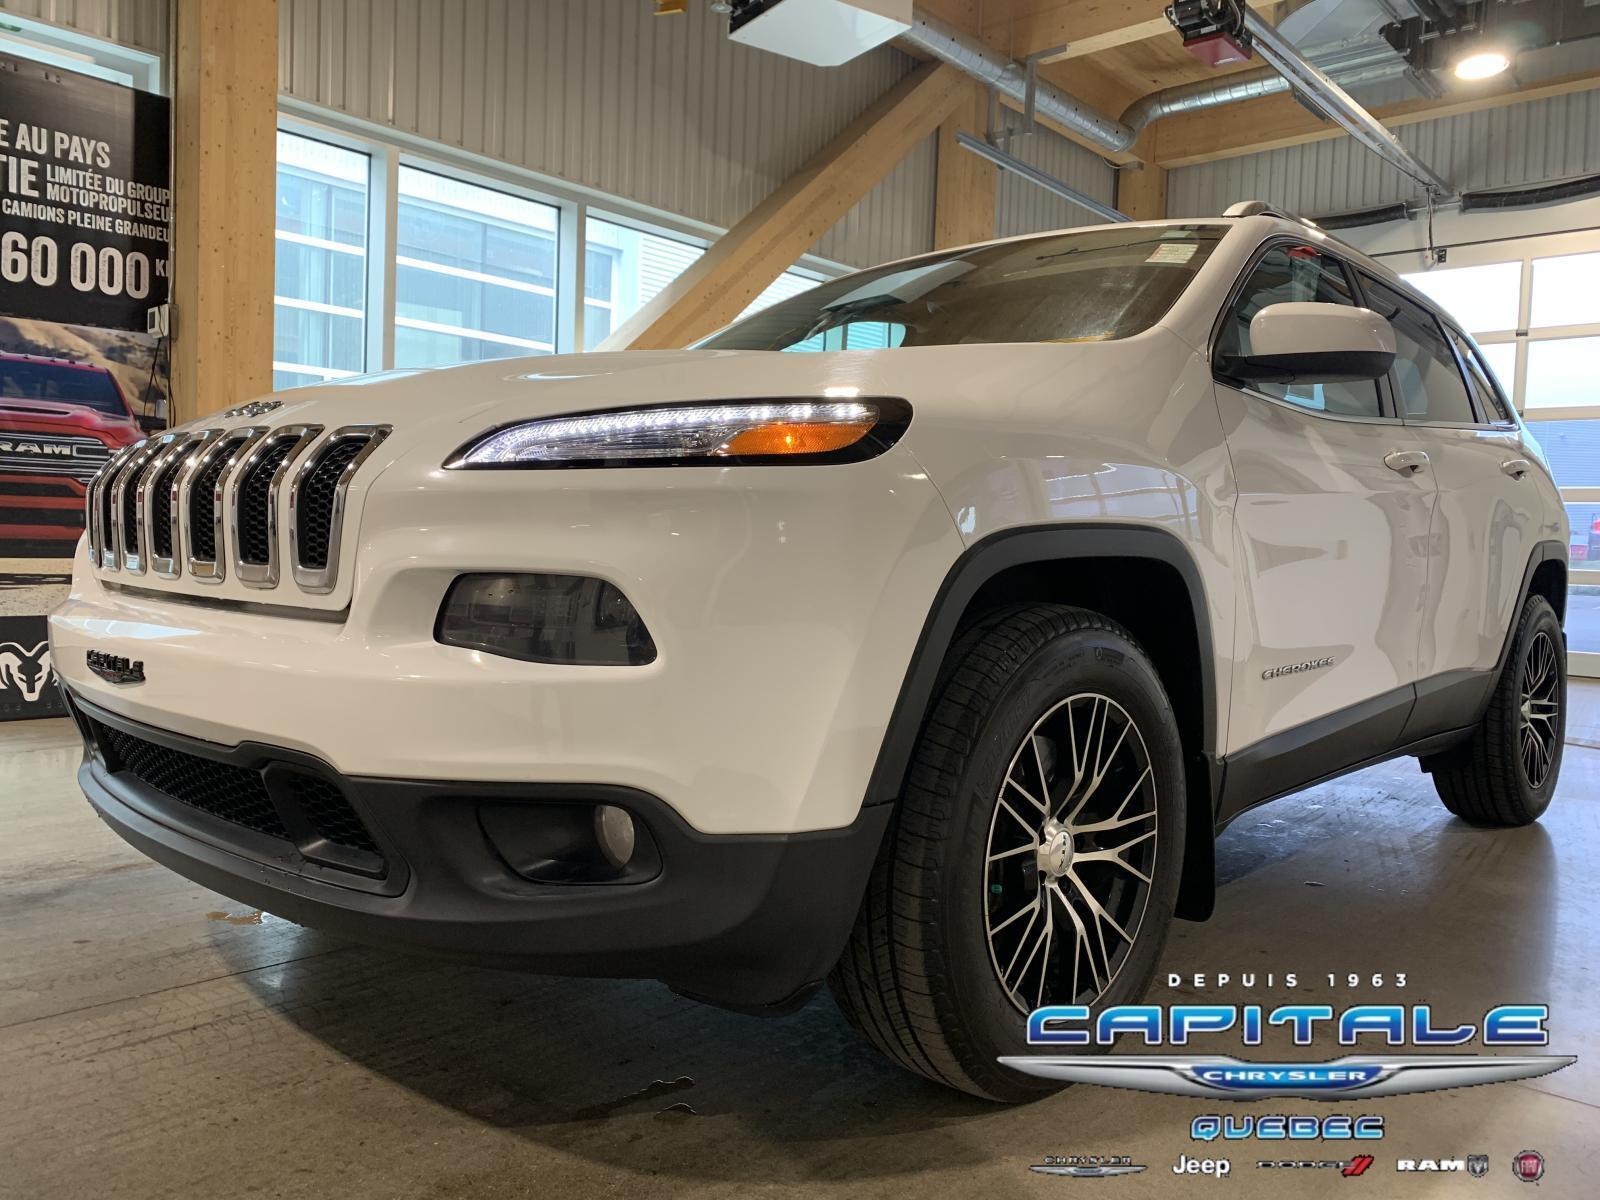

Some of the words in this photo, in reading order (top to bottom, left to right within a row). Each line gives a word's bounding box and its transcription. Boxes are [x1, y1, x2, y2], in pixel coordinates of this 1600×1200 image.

[15, 123, 47, 155] AU
[55, 131, 110, 168] PAYS
[46, 163, 103, 191] LIMITÉE
[105, 176, 124, 196] DU
[2, 198, 65, 223] CAMIONS
[67, 209, 113, 233] PLEINE
[1, 231, 58, 287] 60
[70, 242, 150, 299] 000
[155, 258, 168, 277] K
[0, 441, 72, 456] RAM
[1261, 656, 1336, 680] CHEROKEE
